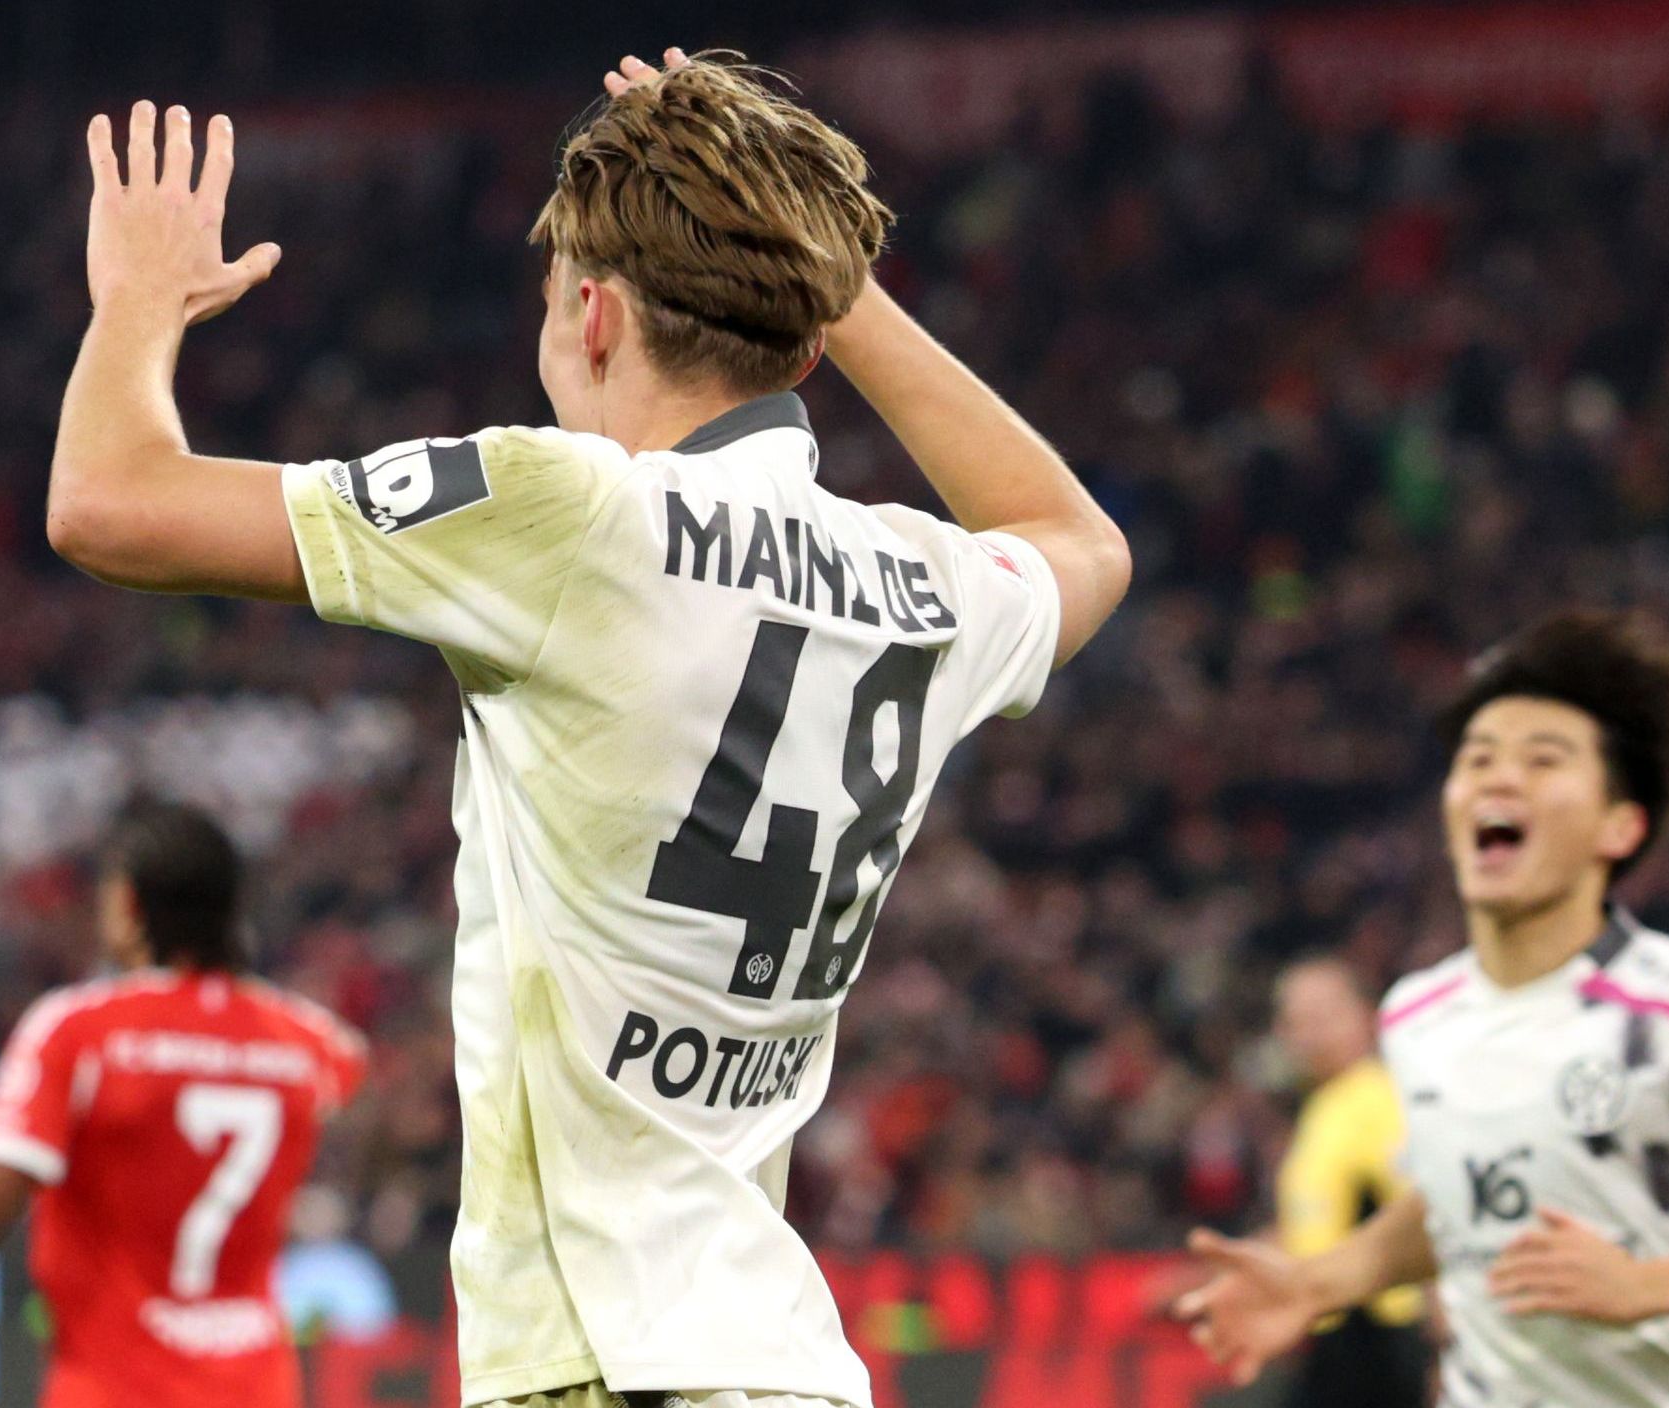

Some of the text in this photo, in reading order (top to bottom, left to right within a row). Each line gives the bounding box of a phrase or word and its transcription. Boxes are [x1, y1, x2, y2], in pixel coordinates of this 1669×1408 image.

[875, 550, 957, 632] 05
[645, 620, 942, 1000] 48
[174, 1081, 283, 1300] 7
